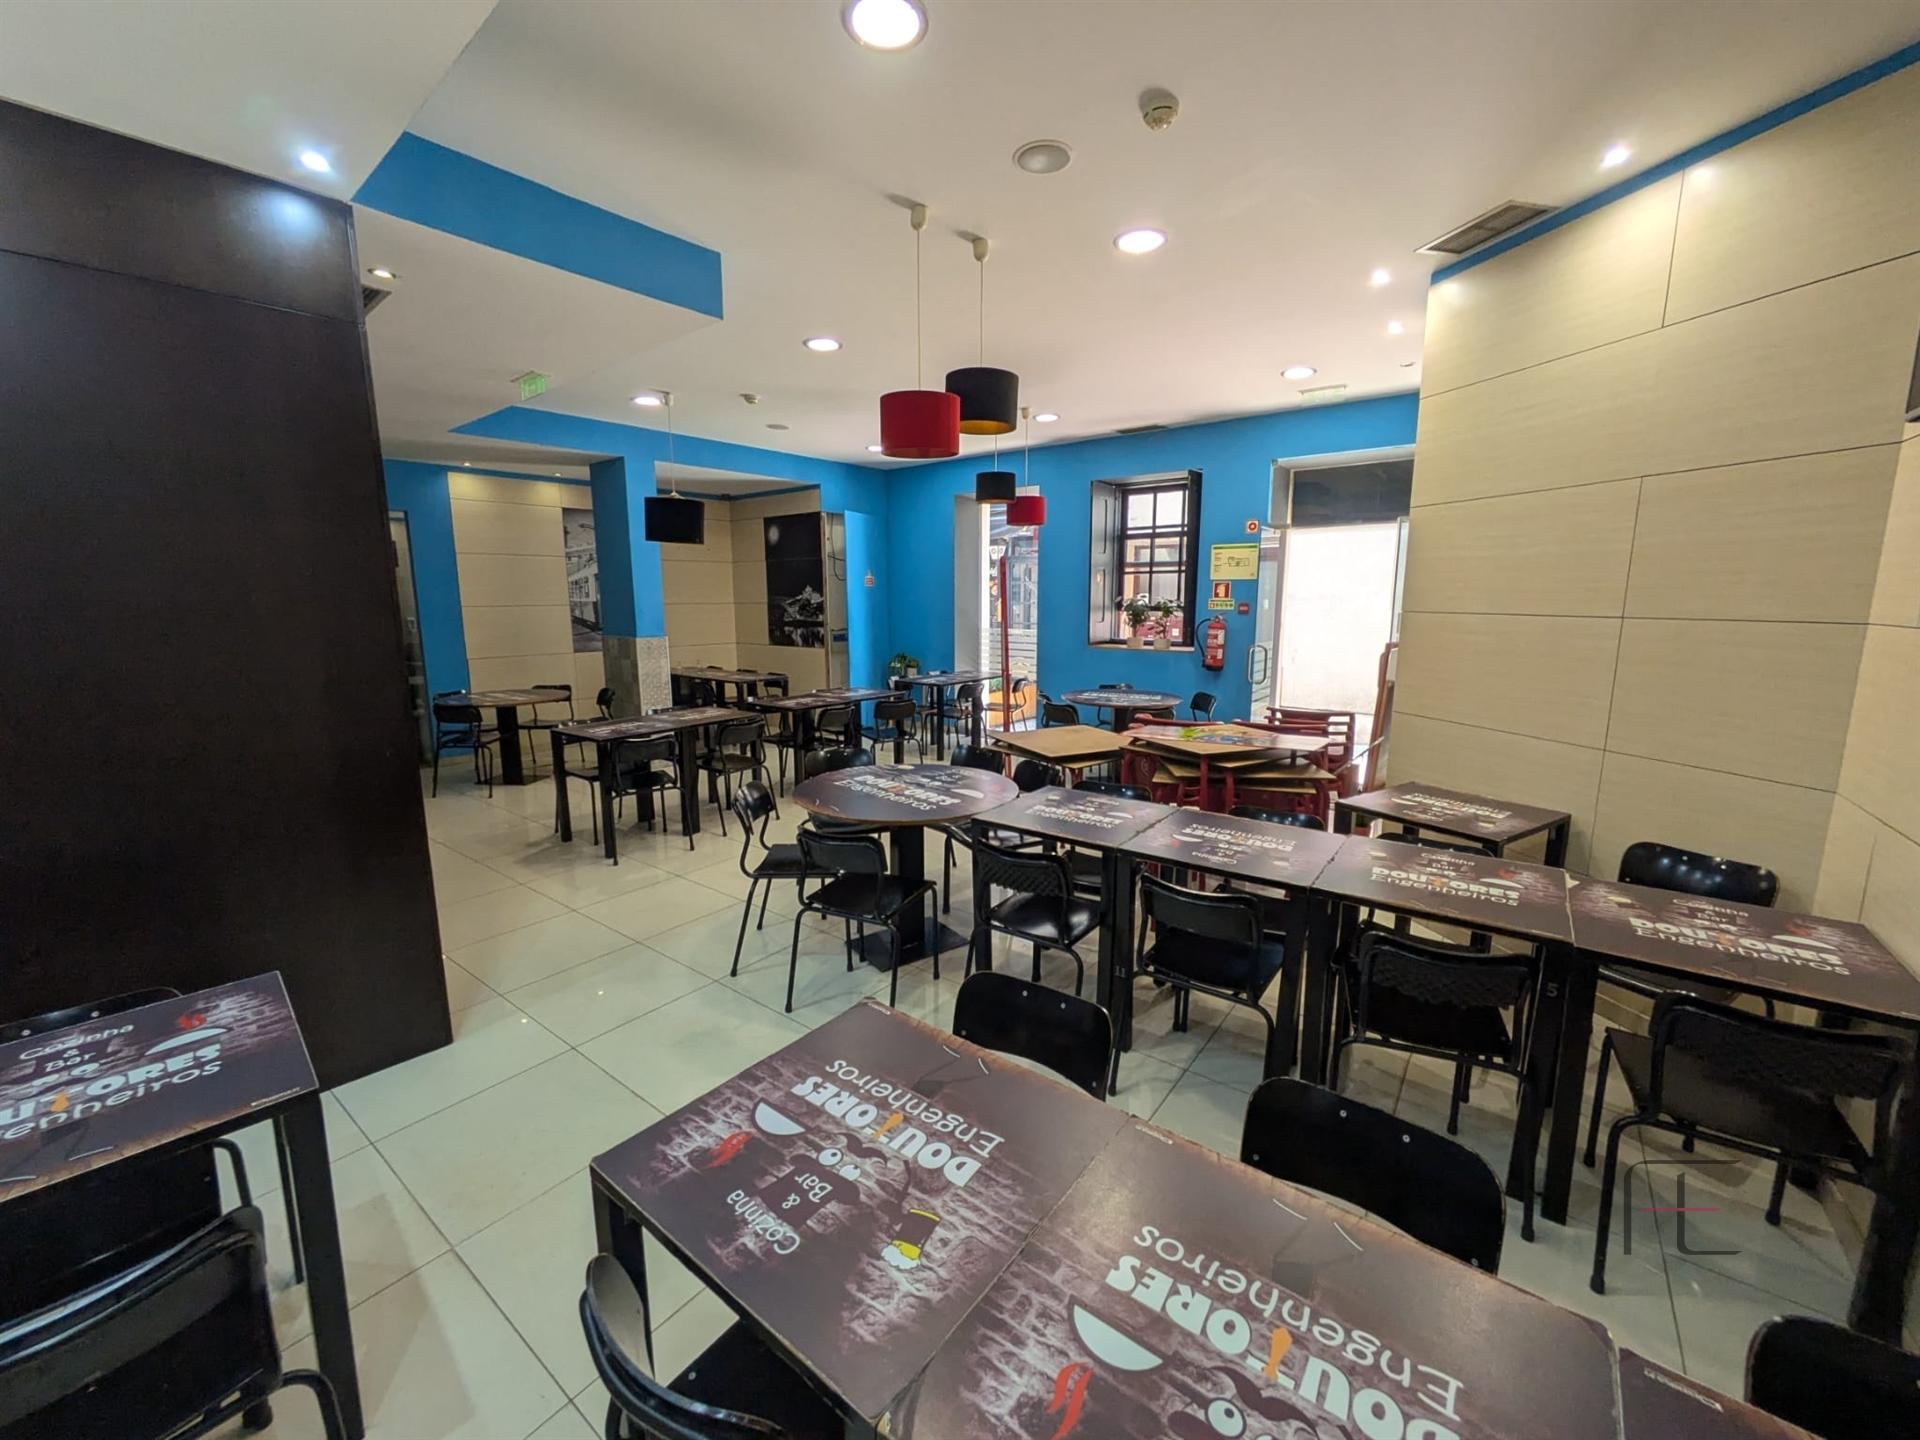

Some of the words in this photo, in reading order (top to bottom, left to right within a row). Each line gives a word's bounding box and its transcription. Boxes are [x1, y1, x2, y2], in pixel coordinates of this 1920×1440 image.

[1370, 873, 1519, 907] Engenheiros
[1371, 866, 1521, 900] DOUTORES
[1629, 917, 1844, 966] DOUTORES
[1635, 927, 1851, 976] Engenheiros
[19, 1024, 135, 1061] Cozinha
[45, 1052, 96, 1073] Bar
[0, 1061, 223, 1140] enheiros
[825, 1059, 1005, 1159] Engenheiros
[790, 1076, 982, 1188] DOUTORES
[782, 1193, 801, 1210] &
[794, 1172, 833, 1203] Bar
[727, 1189, 801, 1255] Cozinha
[1133, 1225, 1465, 1422] Engenheiros
